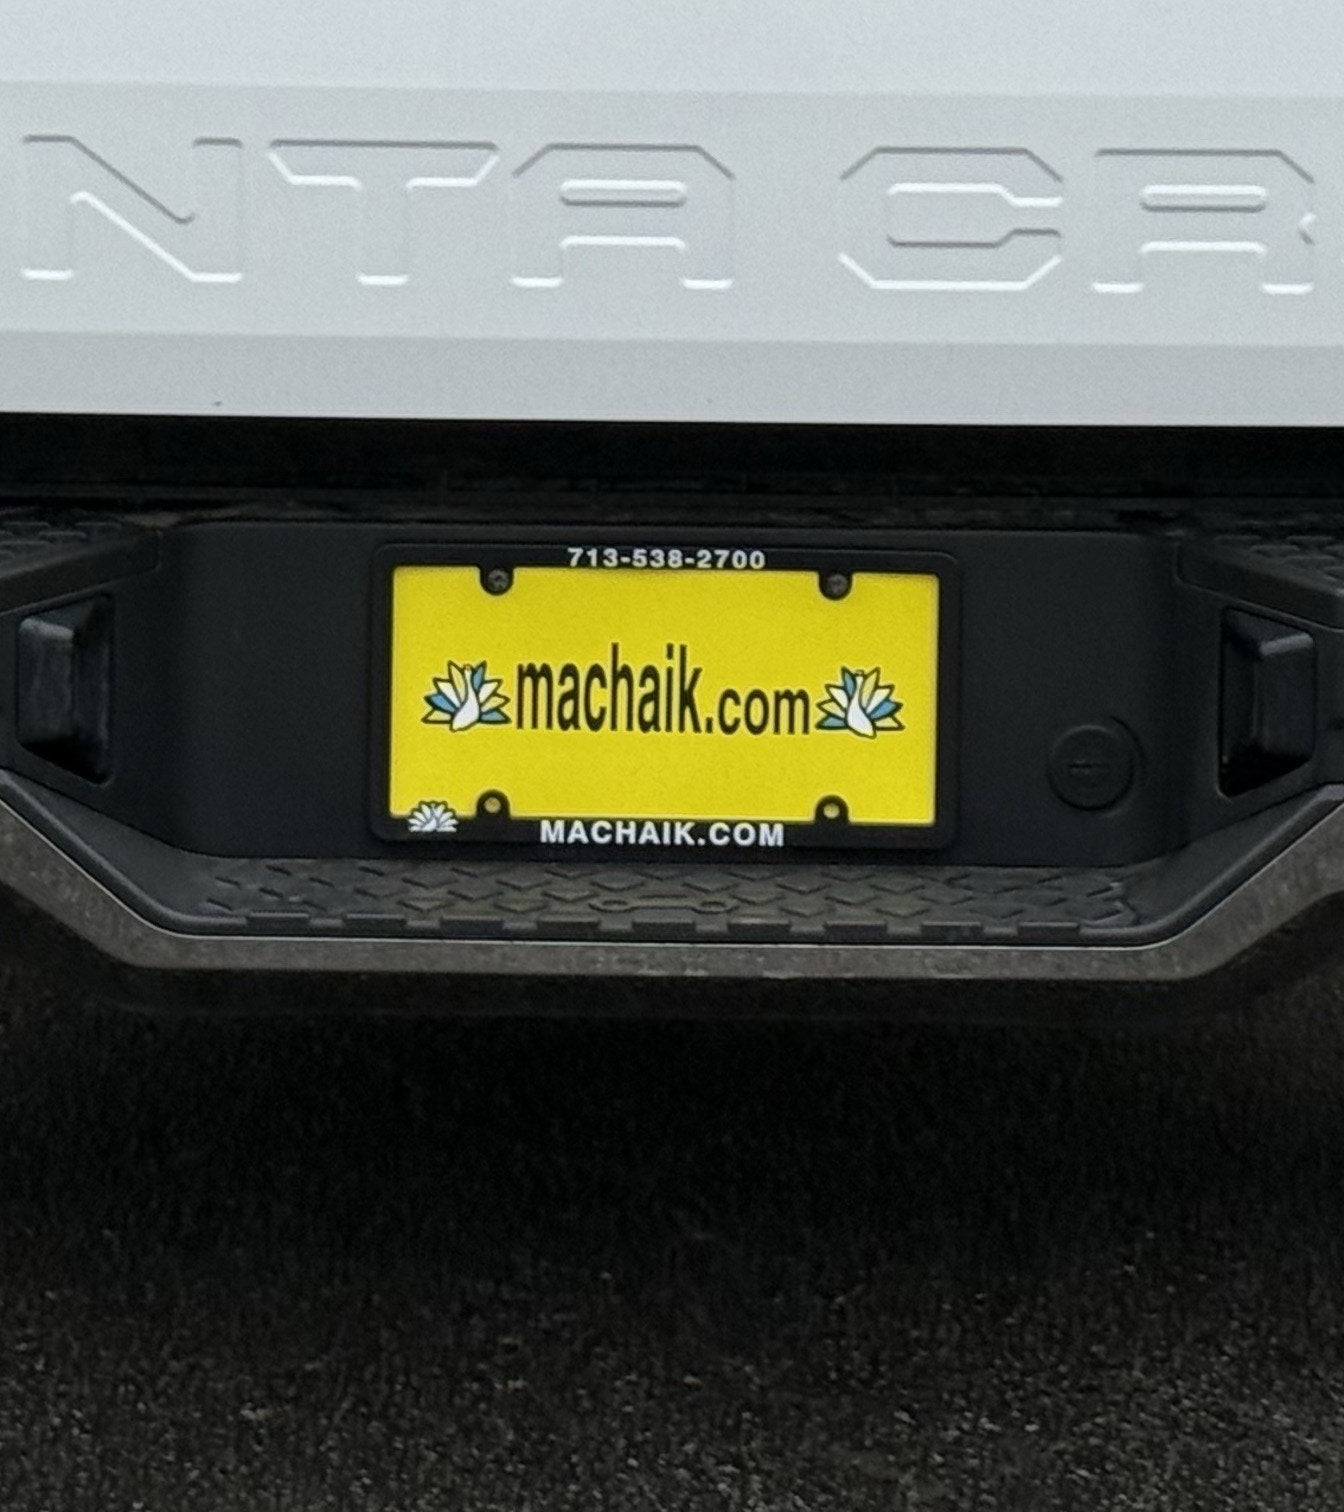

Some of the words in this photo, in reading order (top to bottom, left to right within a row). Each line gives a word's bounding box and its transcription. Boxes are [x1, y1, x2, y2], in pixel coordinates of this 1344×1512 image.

[567, 547, 766, 570] 713-538-2700
[515, 641, 811, 736] machaik.com
[539, 818, 785, 848] MACHAIK.COM
